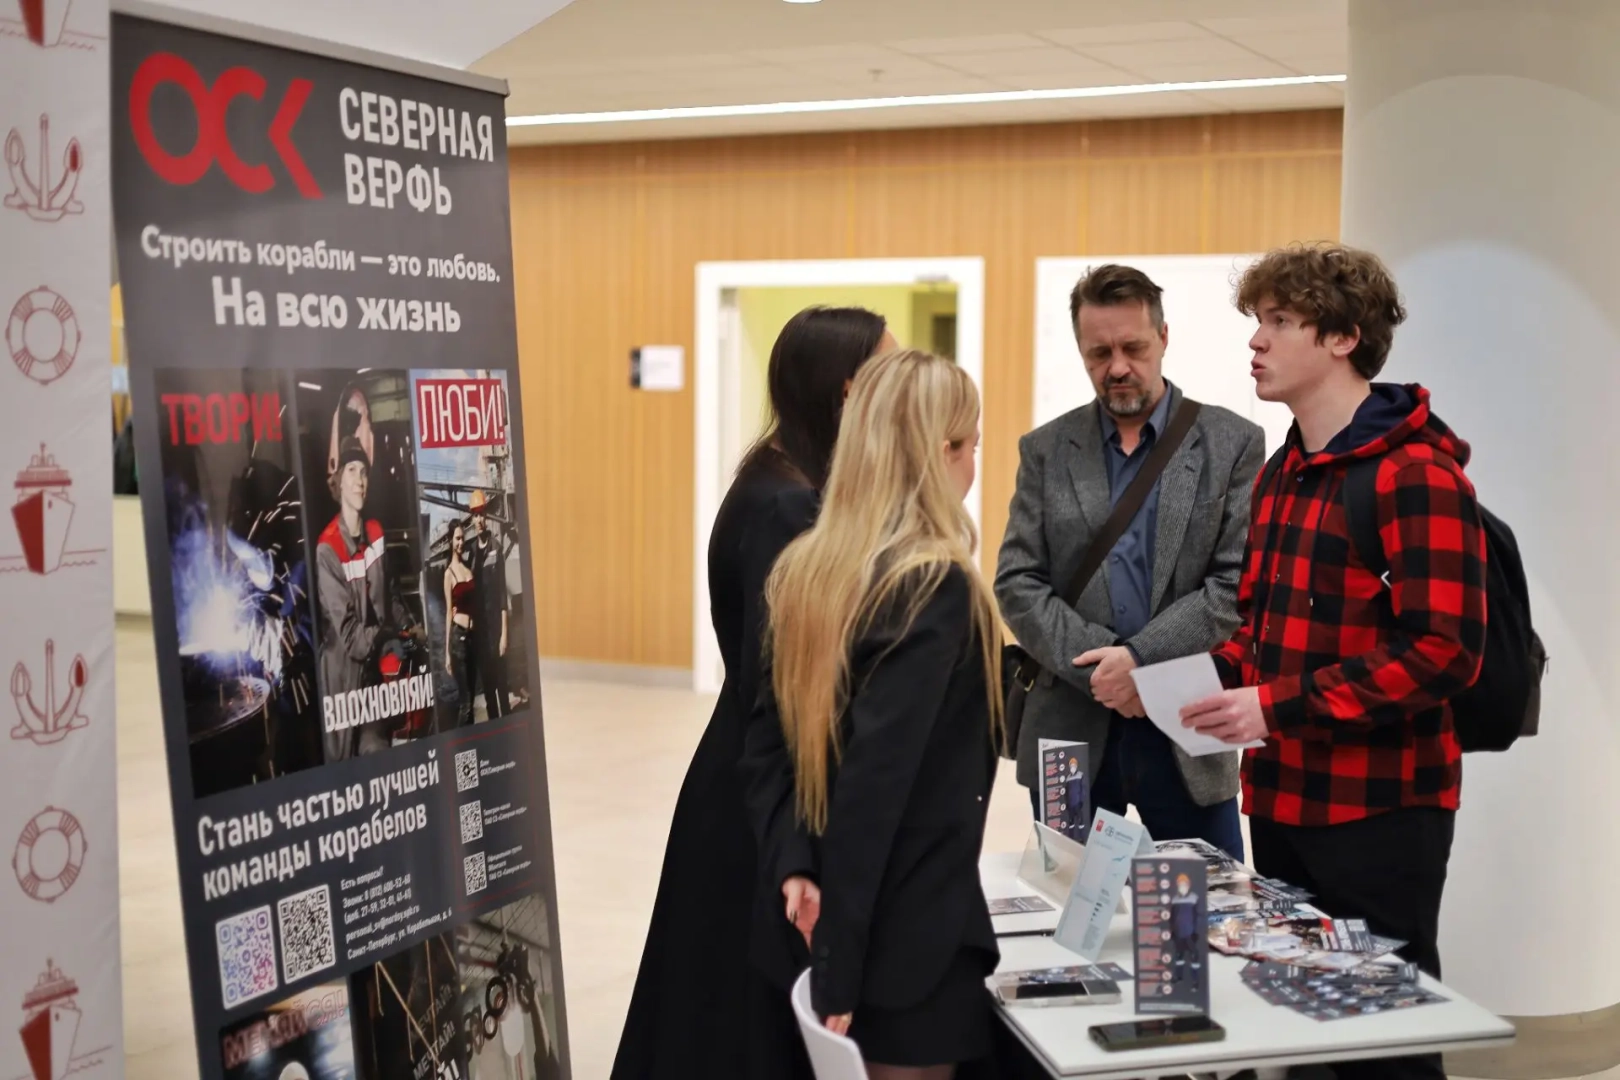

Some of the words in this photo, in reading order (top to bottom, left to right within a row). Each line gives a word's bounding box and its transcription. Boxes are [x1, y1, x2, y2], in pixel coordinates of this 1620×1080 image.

[129, 52, 324, 199] ОСК
[339, 87, 494, 162] СЕВЕРНАЯ
[344, 154, 453, 215] ВЕРФЬ
[141, 225, 252, 267] Строить
[257, 241, 355, 274] корабли
[388, 258, 421, 277] это
[427, 254, 500, 283] любовь.
[212, 276, 266, 326] На
[277, 292, 348, 328] всю
[358, 297, 461, 333] жизнь
[161, 393, 283, 446] ТВОРИ!
[420, 384, 504, 442] ЛЮБИ!
[323, 666, 435, 733] ВДОХНОВЛЯЙ!
[198, 810, 273, 856] Стань
[277, 787, 364, 829] частью
[369, 749, 440, 805] лучшей
[203, 841, 311, 901] команды
[318, 803, 427, 862] корабелов
